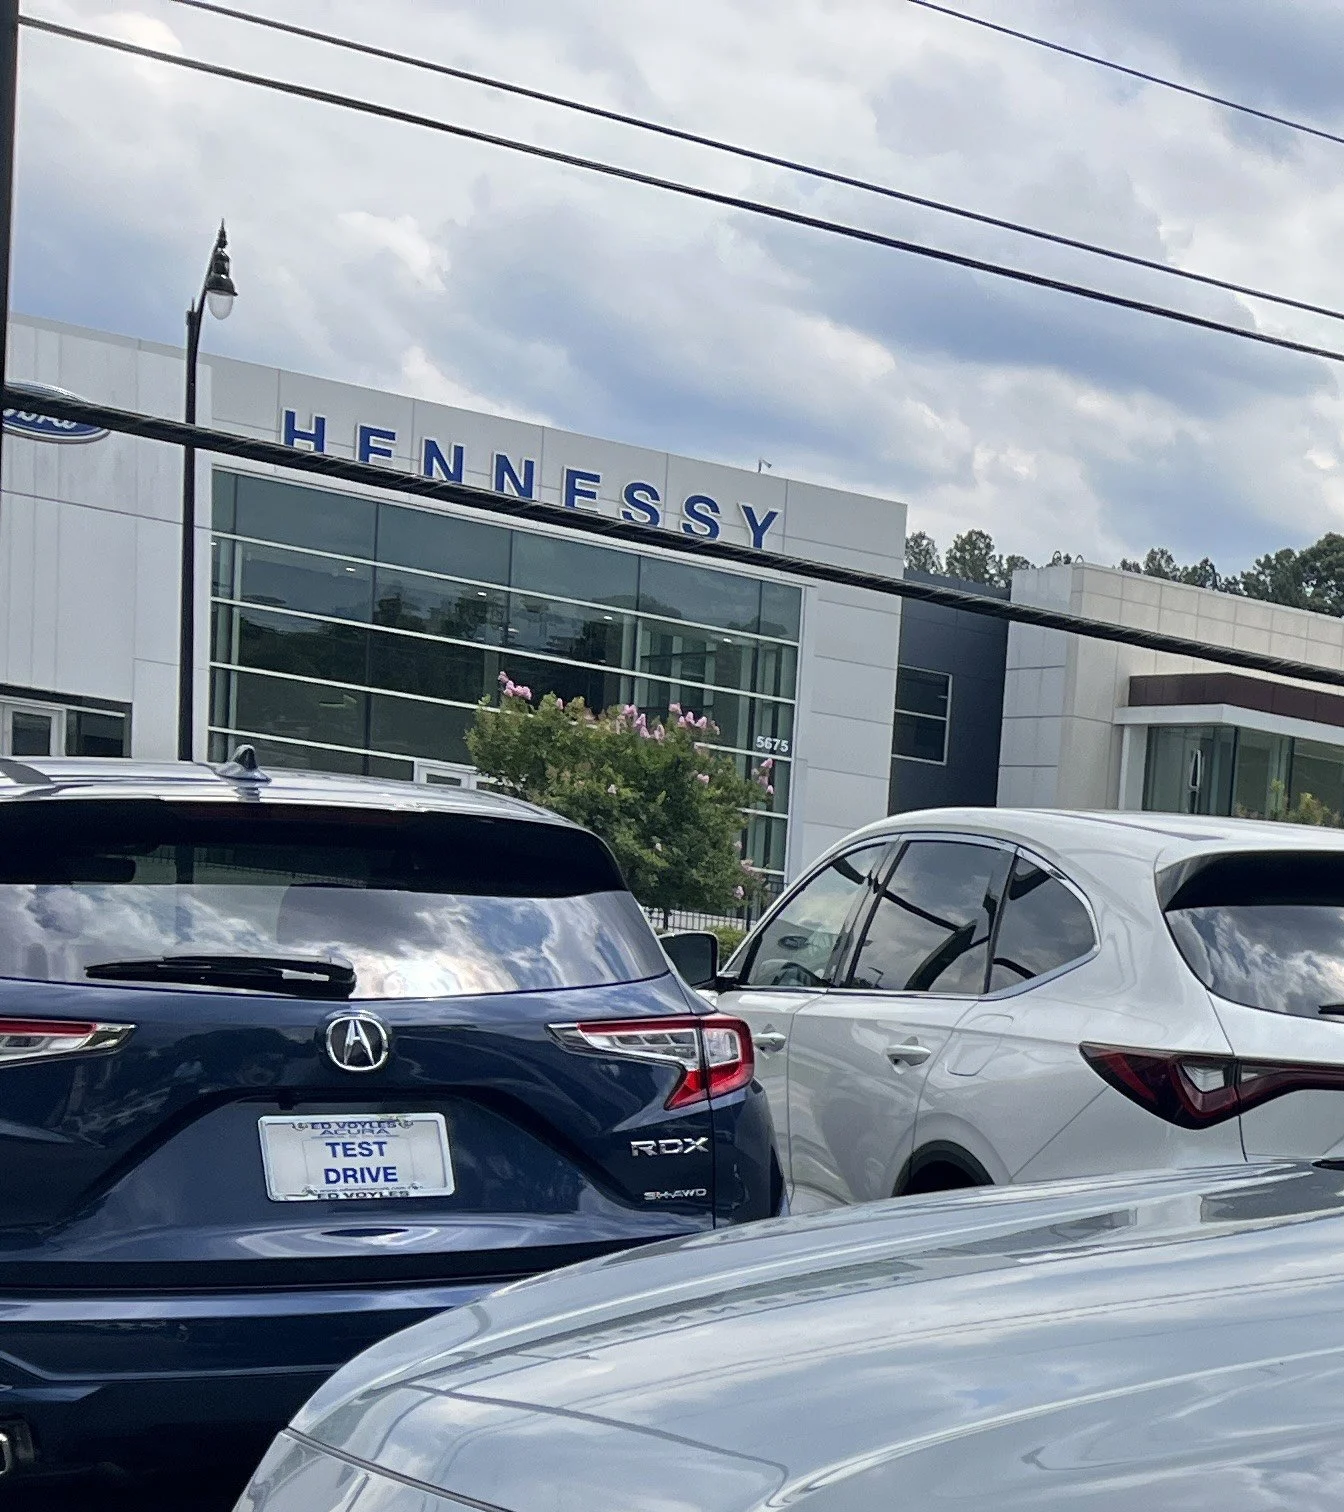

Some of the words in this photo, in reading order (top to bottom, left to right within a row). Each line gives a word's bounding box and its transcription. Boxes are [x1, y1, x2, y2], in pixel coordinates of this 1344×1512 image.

[283, 409, 779, 549] HENNESSY
[756, 735, 789, 752] 5675
[325, 1141, 388, 1158] TEST
[630, 1136, 709, 1156] RDX
[323, 1166, 398, 1185] DRIVE
[643, 1188, 707, 1201] SH-AWD
